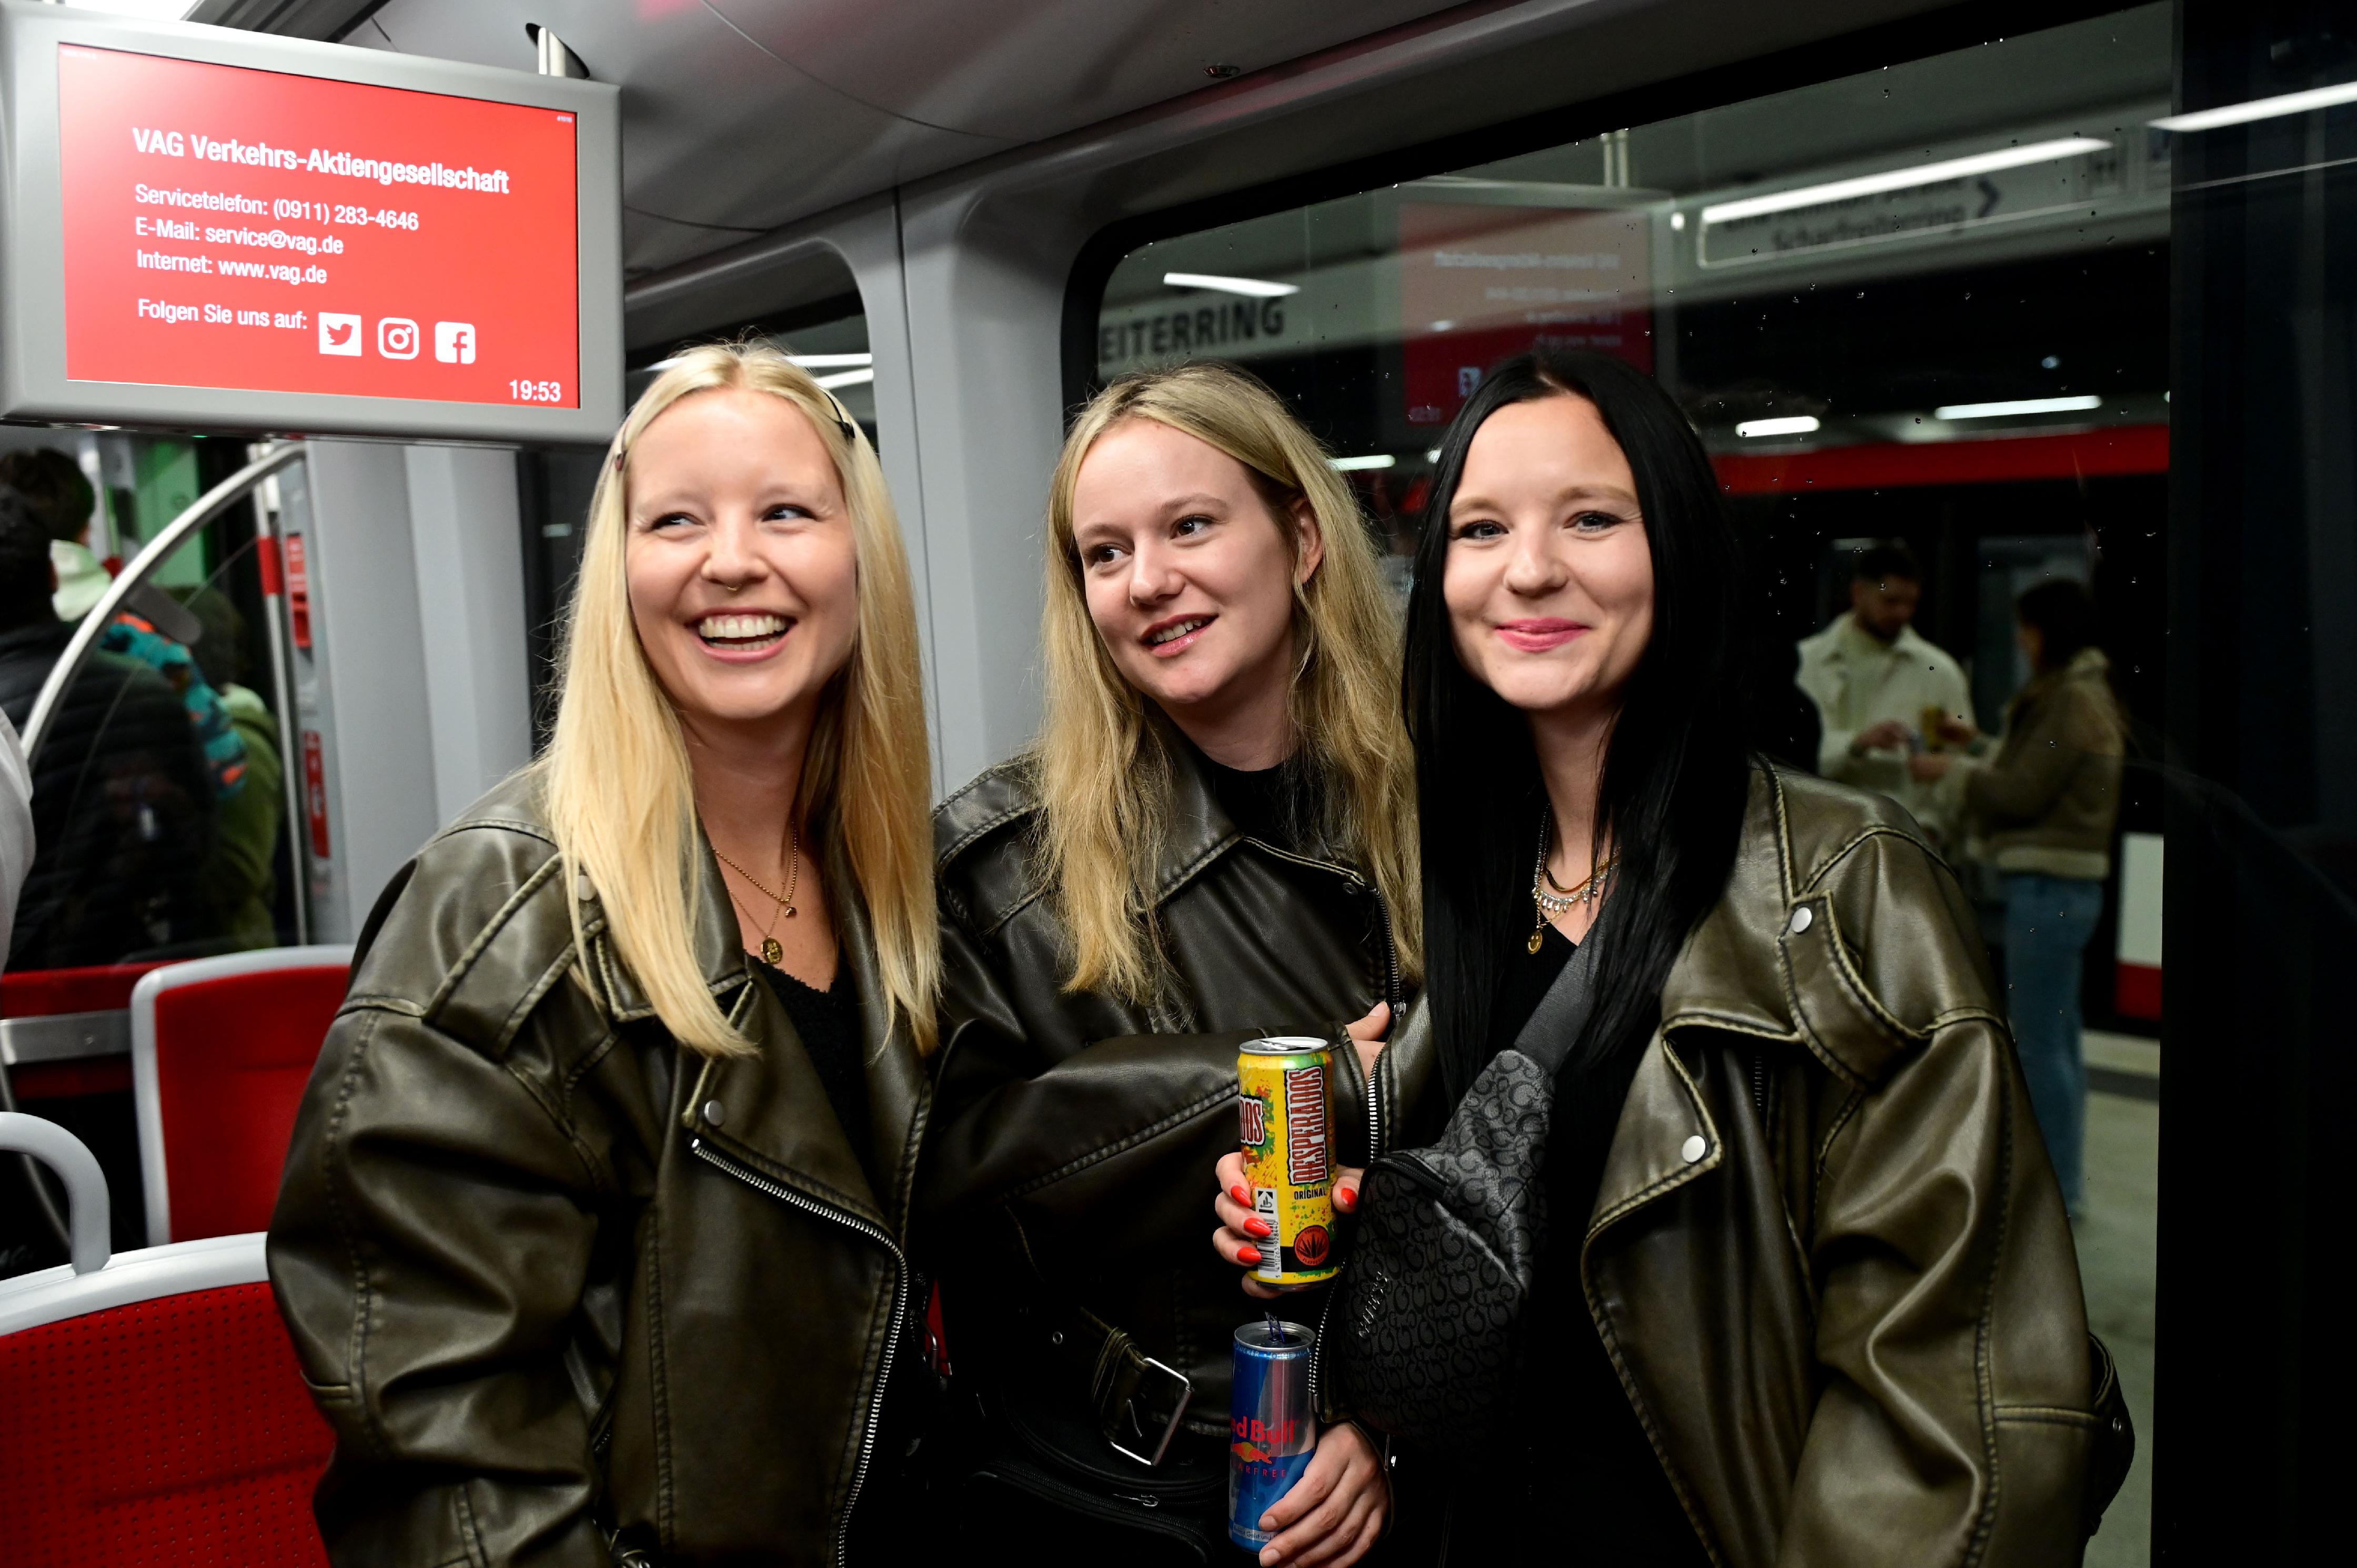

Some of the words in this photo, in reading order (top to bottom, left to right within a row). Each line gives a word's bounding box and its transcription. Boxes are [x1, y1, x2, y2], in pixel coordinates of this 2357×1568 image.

[132, 127, 184, 157] VAG
[190, 134, 510, 194] Verkehrs-Aktiengesellschaft
[135, 183, 268, 215] Servicetelefon:
[273, 198, 330, 226] (0911)
[334, 205, 419, 231] 283-4646
[135, 216, 200, 241] E-Mail:
[205, 227, 344, 256] service@vag.de
[137, 249, 213, 274] Internet:
[218, 260, 328, 285] www.vag.de
[138, 298, 199, 324] Folgen
[204, 304, 233, 324] Sie
[237, 310, 270, 327] uns
[274, 310, 308, 329] auf:
[509, 379, 561, 402] 19:53
[1288, 1067, 1327, 1183] DESPERADOS
[1294, 1187, 1326, 1200] ORIGINAL
[1250, 1419, 1295, 1445] Bull
